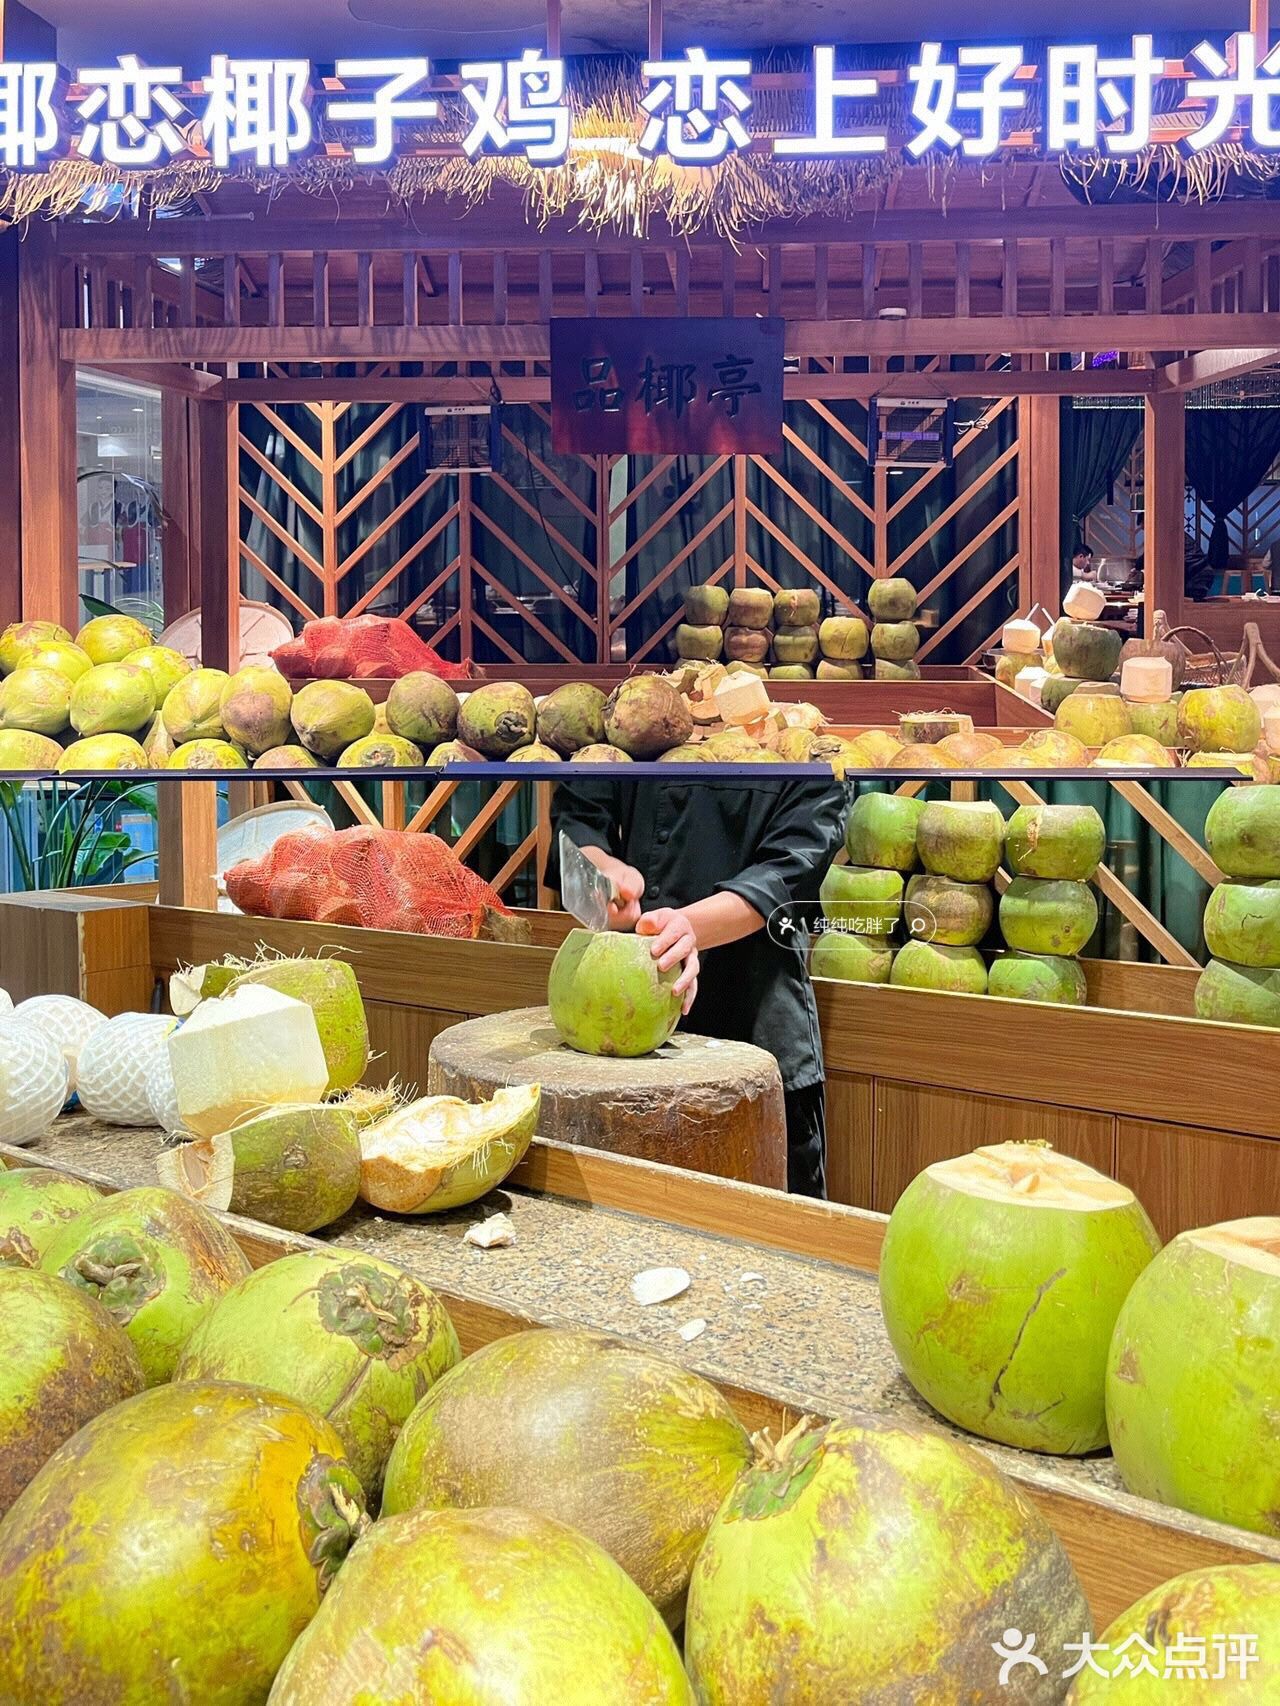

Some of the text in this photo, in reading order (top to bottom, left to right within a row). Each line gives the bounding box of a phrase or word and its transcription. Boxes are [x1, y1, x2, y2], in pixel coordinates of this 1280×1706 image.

[639, 32, 1280, 164] 恋上好时光
[573, 354, 761, 419] 品椰亭
